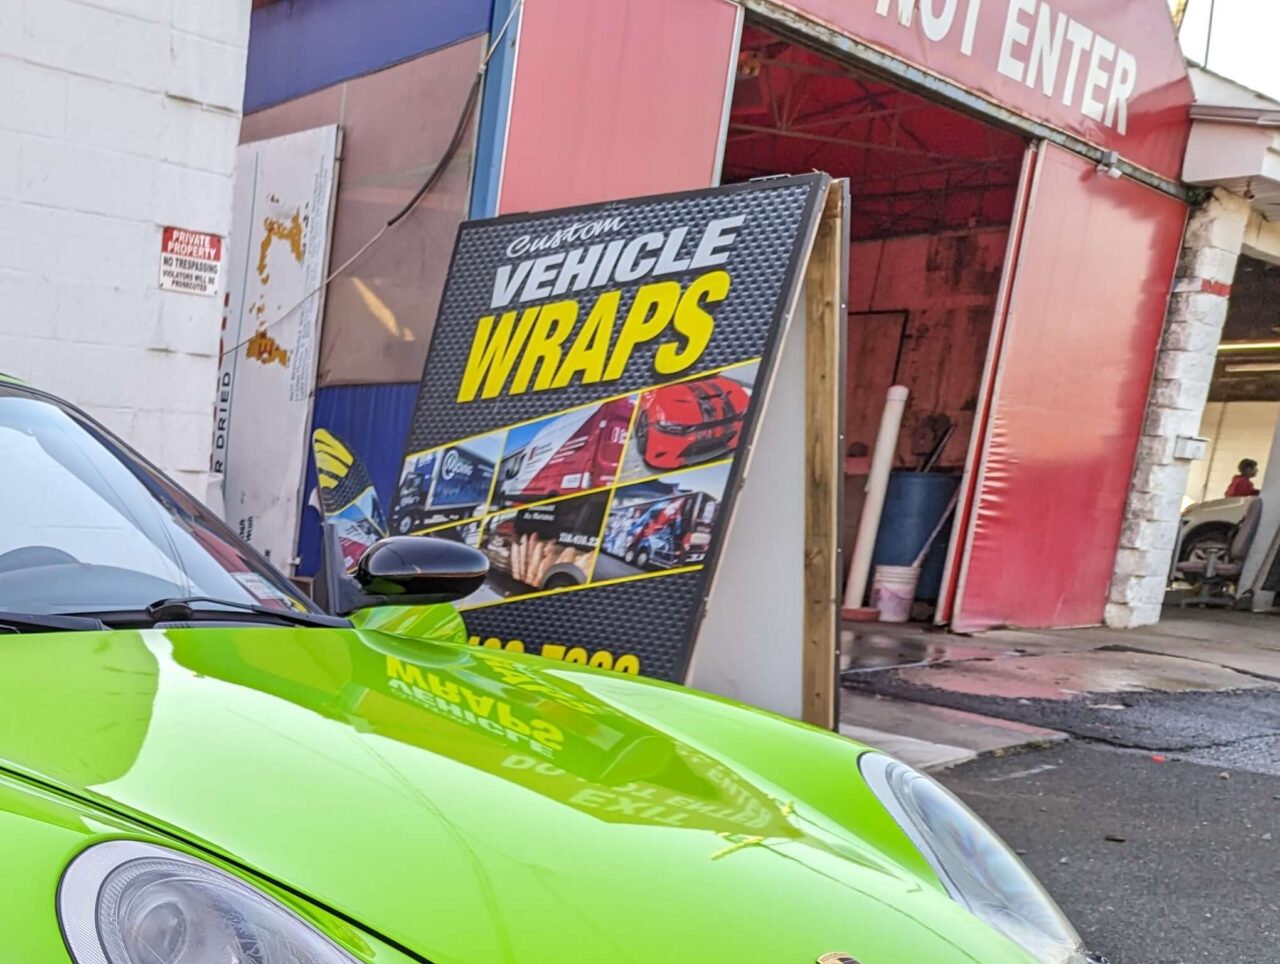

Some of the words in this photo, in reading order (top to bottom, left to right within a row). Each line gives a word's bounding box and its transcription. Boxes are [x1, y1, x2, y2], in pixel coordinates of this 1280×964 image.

[997, 0, 1137, 136] ENTER
[168, 241, 217, 260] PROPERTY
[173, 230, 211, 248] PRIVATE
[506, 216, 625, 258] Custom
[163, 256, 173, 267] NO
[175, 258, 218, 275] TRESPASSING
[490, 214, 747, 308] VEHICLE
[163, 270, 193, 281] VIOLATORS
[195, 275, 207, 284] WILL
[209, 277, 215, 285] BE
[172, 280, 207, 292] PROSECUTED
[456, 270, 732, 403] WRAPS
[215, 371, 231, 449] DRIED
